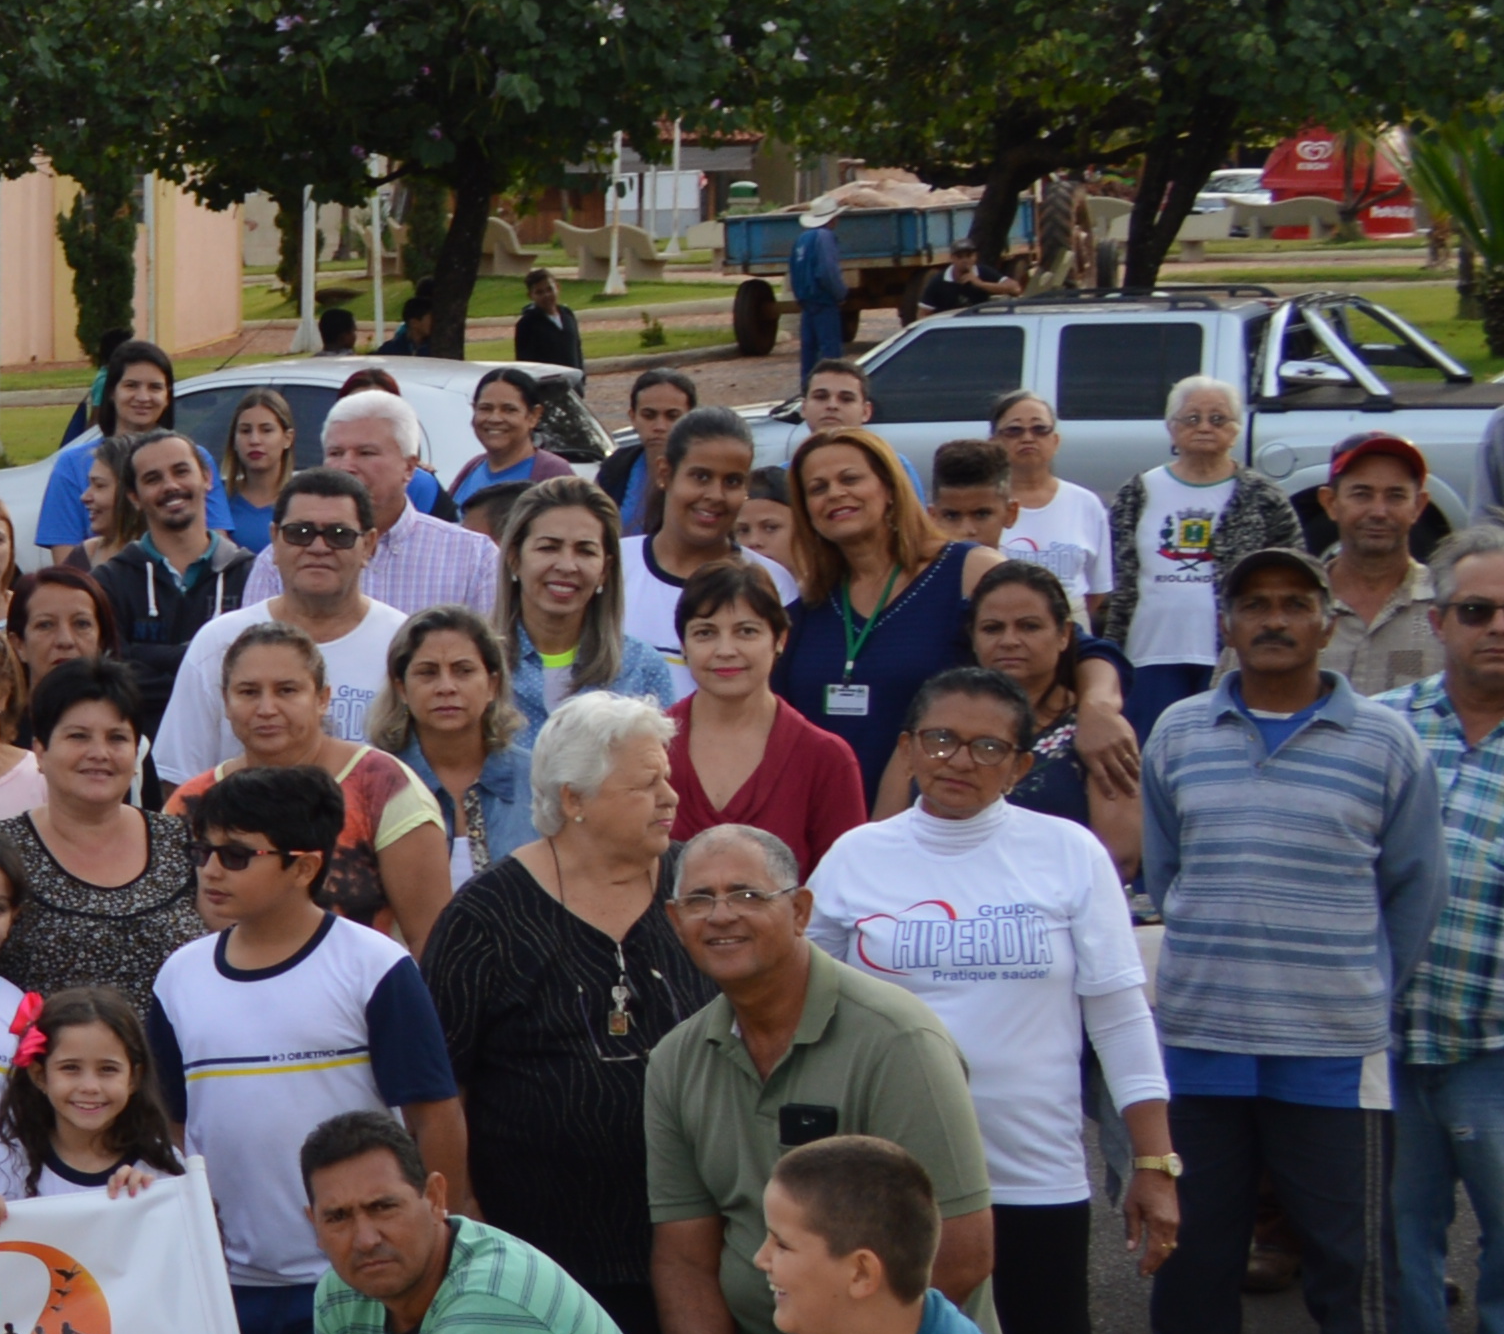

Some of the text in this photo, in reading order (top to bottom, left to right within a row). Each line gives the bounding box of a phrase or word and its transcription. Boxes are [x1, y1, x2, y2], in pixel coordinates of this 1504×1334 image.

[338, 685, 375, 699] Grup
[978, 903, 1037, 917] Grupo
[892, 915, 1054, 969] HIPERDIA
[933, 970, 997, 982] Pratique
